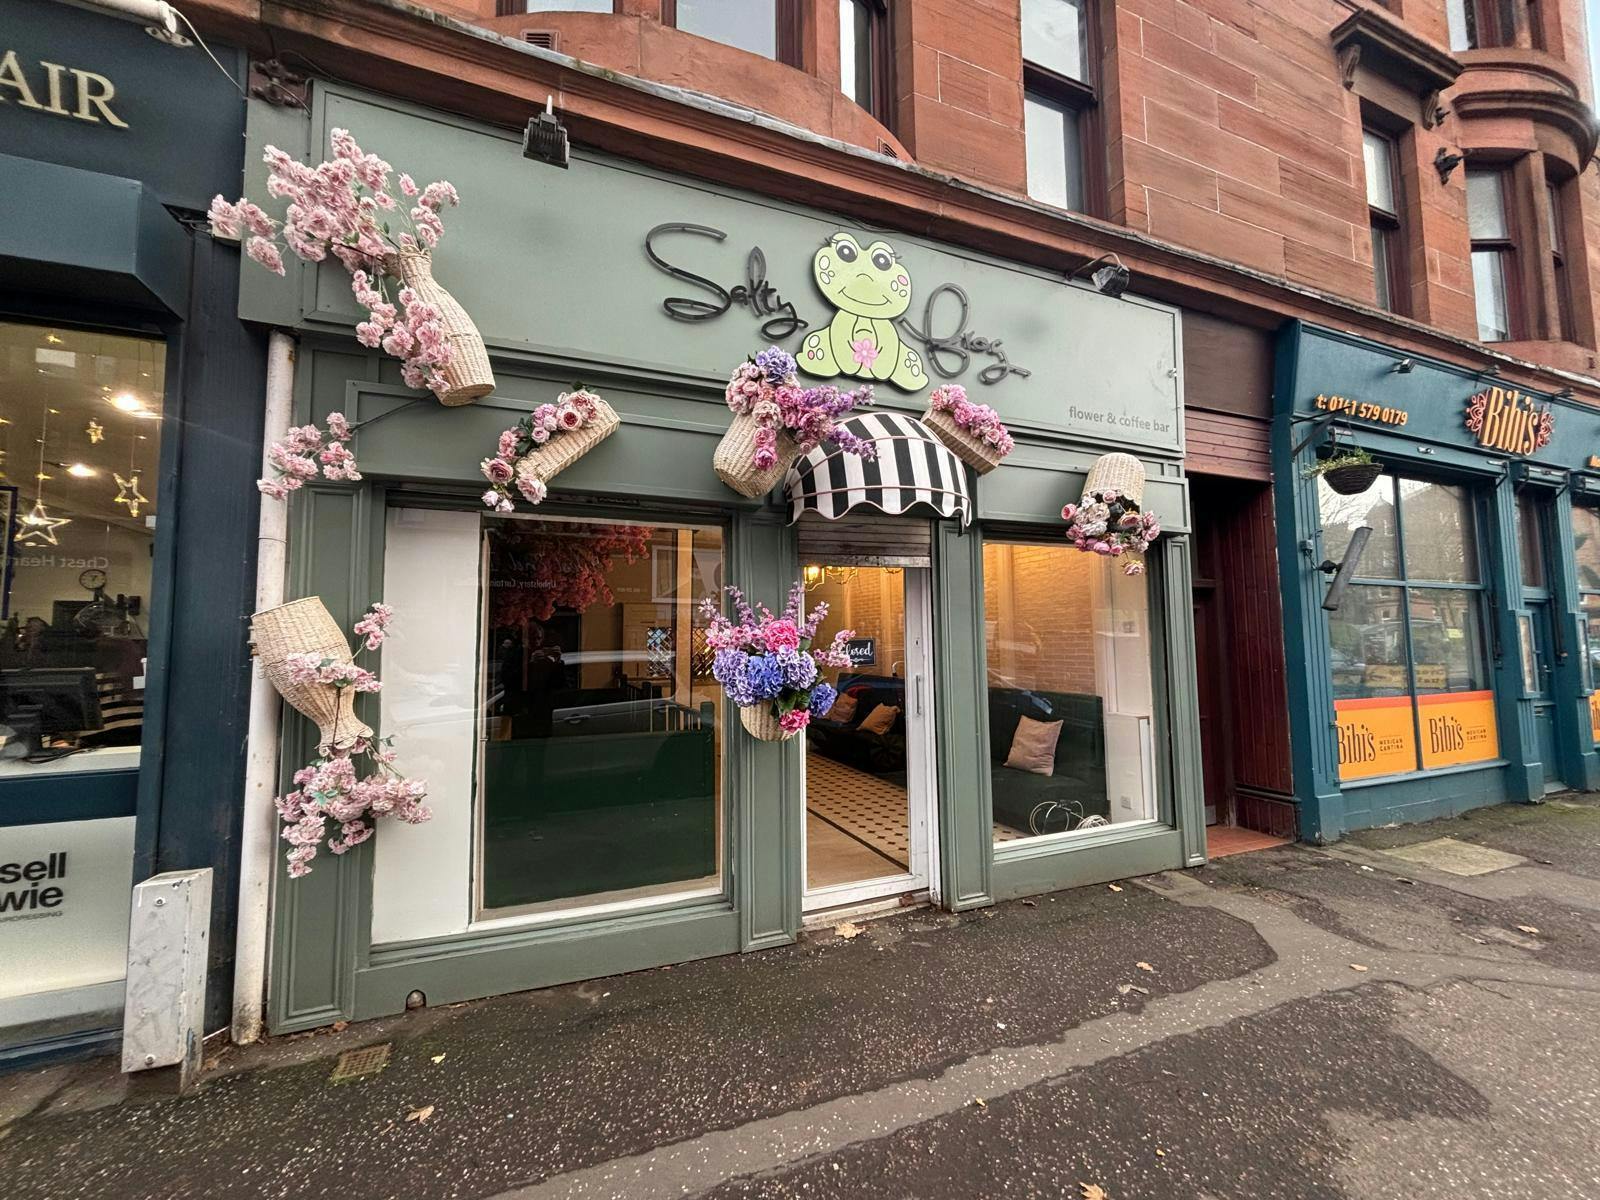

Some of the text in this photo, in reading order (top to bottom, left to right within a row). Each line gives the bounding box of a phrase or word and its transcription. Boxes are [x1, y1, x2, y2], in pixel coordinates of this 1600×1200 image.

[0, 50, 129, 128] AIR
[645, 222, 809, 341] Salty
[1069, 406, 1170, 433] flower & coffee bar
[1328, 396, 1357, 416] 0141
[1358, 403, 1380, 420] 579
[1381, 408, 1409, 426] 0179
[1481, 386, 1539, 456] Bibi's
[844, 641, 873, 656] losed
[1337, 723, 1376, 764] Bibi's
[1428, 715, 1465, 754] Bibi's
[0, 852, 67, 884] sell
